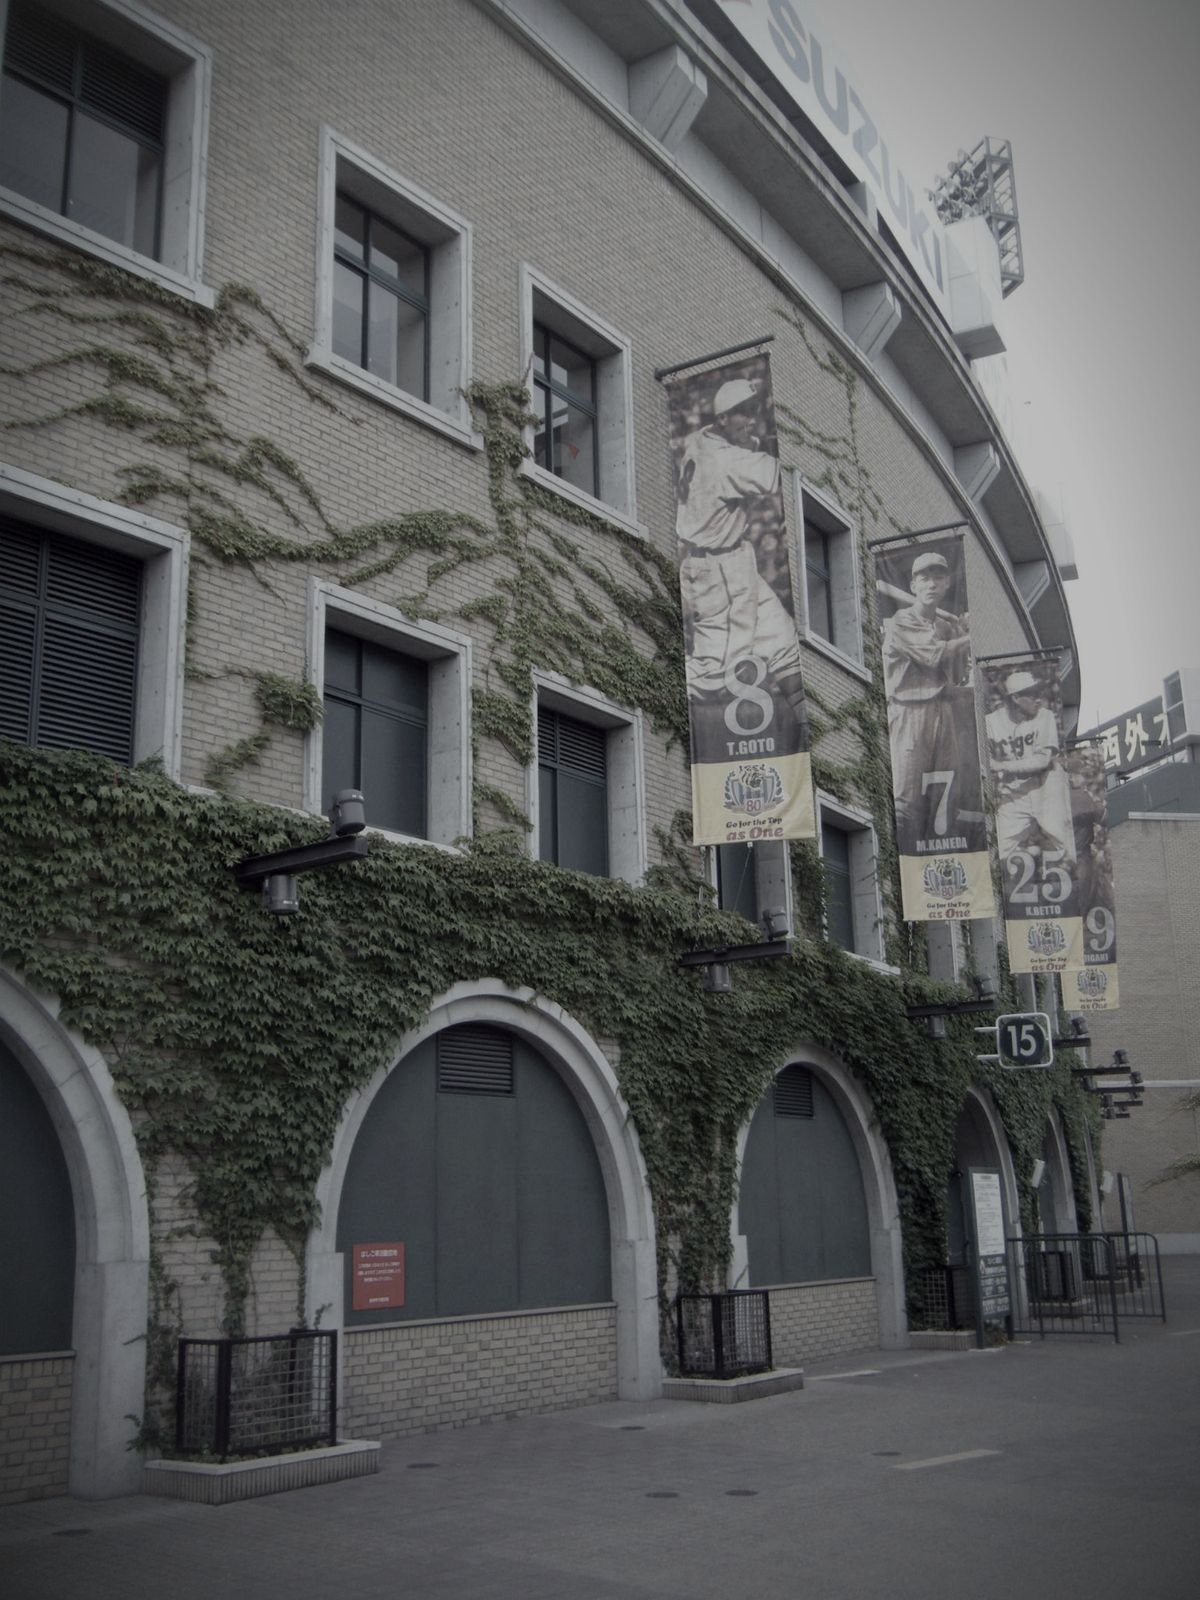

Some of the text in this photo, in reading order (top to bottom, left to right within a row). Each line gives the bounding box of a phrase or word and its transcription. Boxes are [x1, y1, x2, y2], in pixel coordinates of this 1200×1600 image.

[767, 0, 943, 294] SUZUKI
[724, 654, 774, 736] 8
[726, 737, 776, 757] T.GOTO
[746, 799, 762, 812] 80
[922, 770, 955, 835] 7
[726, 816, 783, 829] Go for the Top
[726, 827, 784, 841] as One
[916, 836, 968, 852] M.KANEDA
[1006, 849, 1073, 904] 25
[945, 908, 971, 918] One
[1086, 906, 1115, 952] 9
[1007, 1024, 1037, 1057] 15
